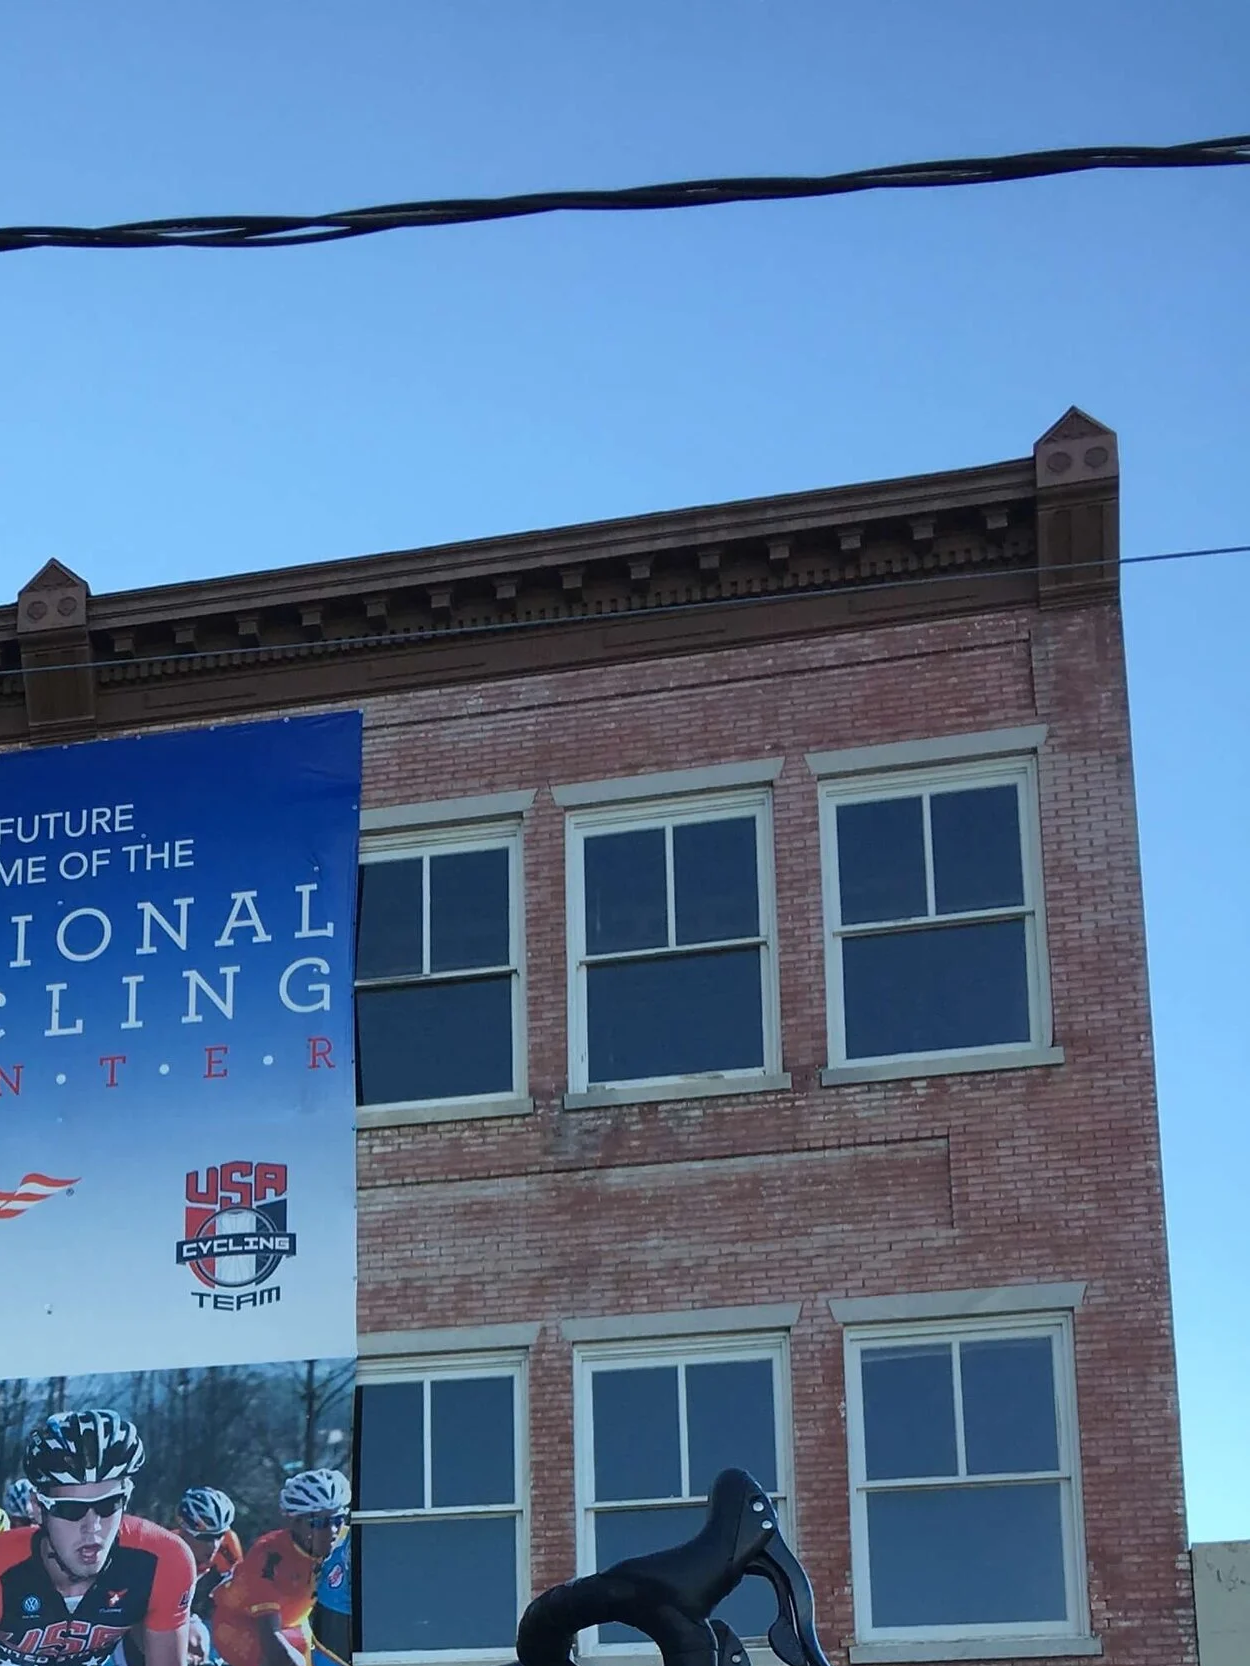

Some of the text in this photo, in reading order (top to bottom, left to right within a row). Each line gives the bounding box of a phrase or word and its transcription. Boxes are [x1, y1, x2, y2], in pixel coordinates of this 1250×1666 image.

[59, 849, 112, 881] OF
[122, 840, 195, 873] THE
[187, 1161, 287, 1209] USA
[183, 1237, 290, 1257] CYCLING
[191, 1286, 281, 1311] TEAM
